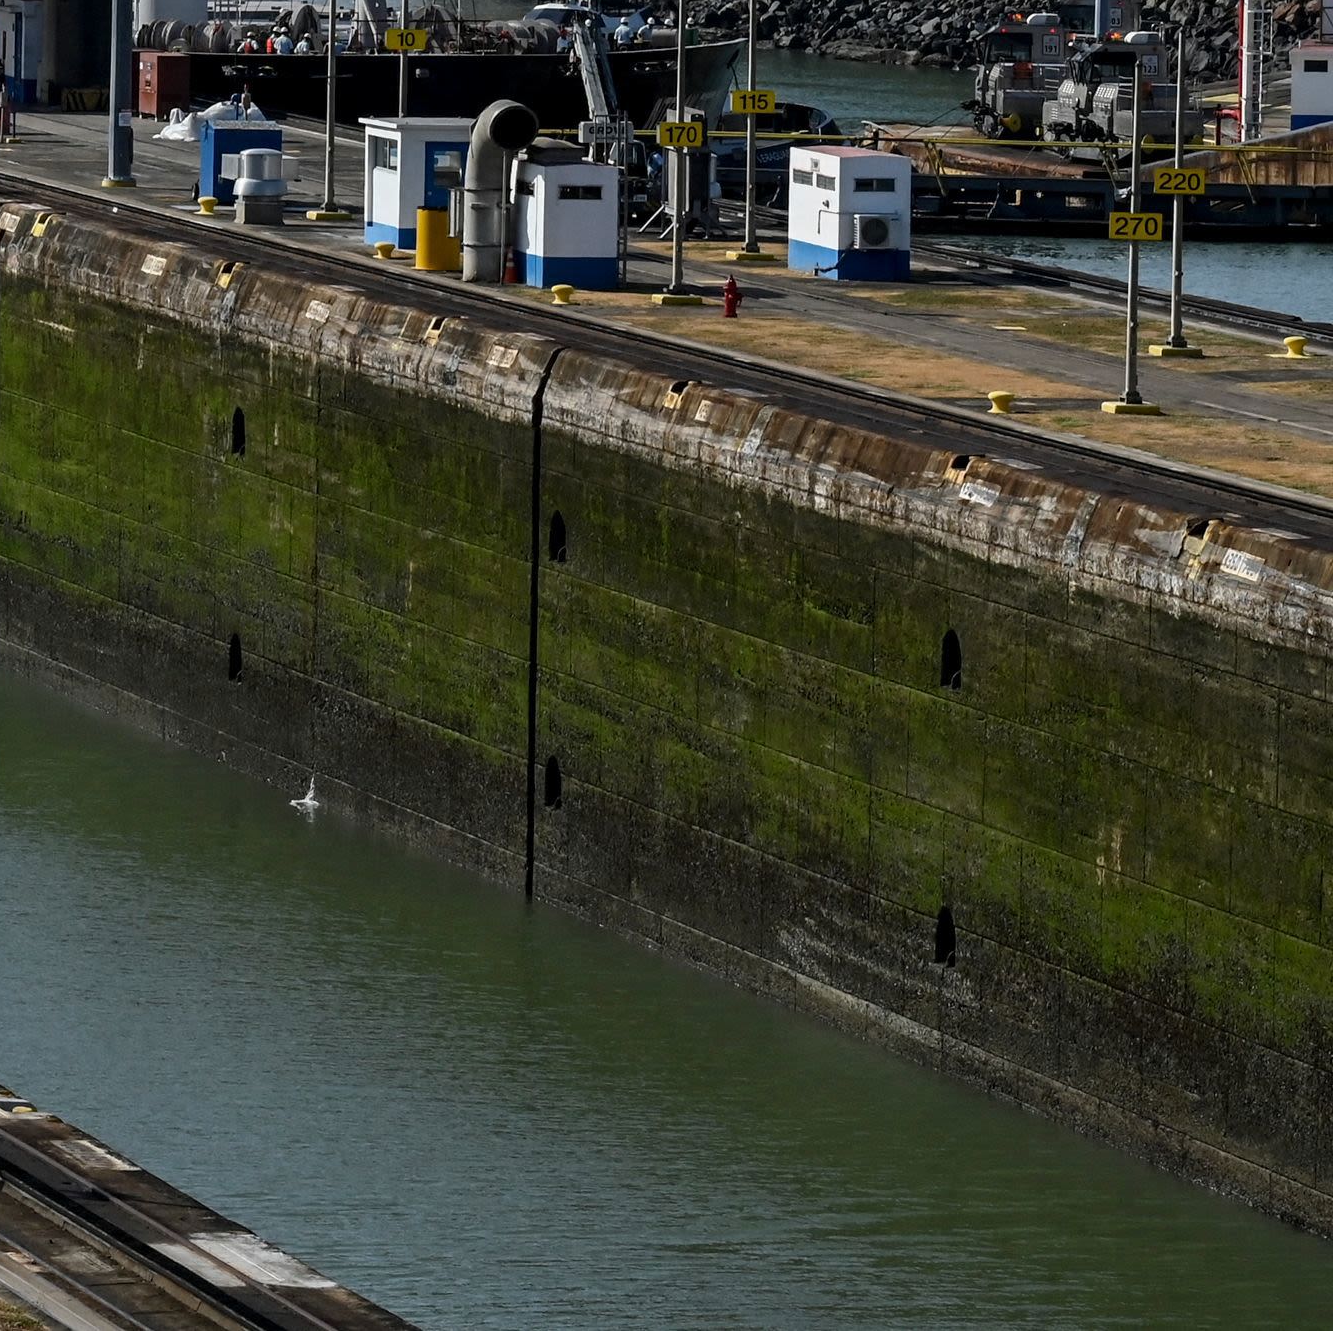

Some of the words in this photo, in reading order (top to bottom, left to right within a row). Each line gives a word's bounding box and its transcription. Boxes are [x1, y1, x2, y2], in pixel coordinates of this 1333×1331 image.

[397, 32, 415, 47] 10
[740, 94, 768, 110] 115
[666, 126, 697, 143] 170
[1159, 173, 1201, 190] 220
[1114, 217, 1158, 236] 270
